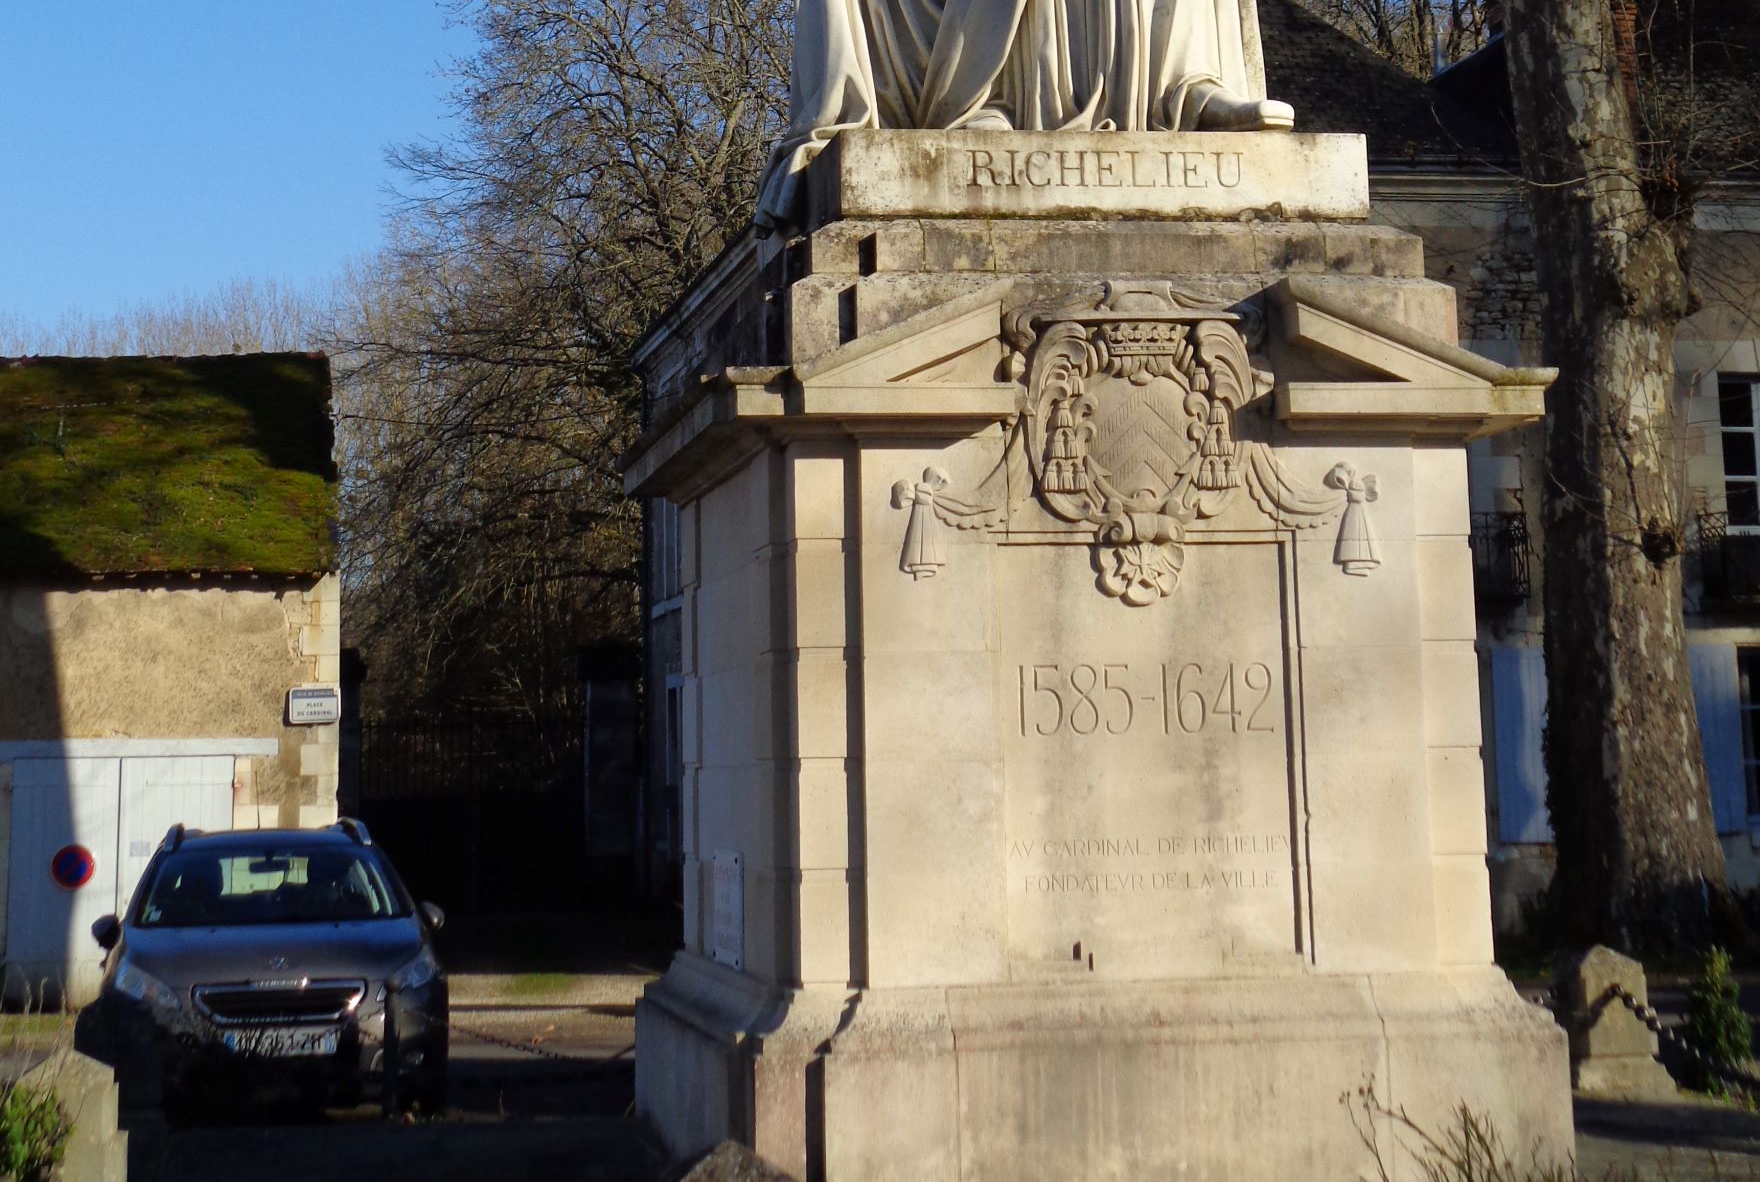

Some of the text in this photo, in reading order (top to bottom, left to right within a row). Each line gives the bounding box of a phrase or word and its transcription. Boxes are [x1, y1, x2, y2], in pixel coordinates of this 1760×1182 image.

[965, 149, 1244, 189] RICHELIEU
[1018, 662, 1275, 737] 1585-1642
[1043, 838, 1149, 857] CARDINAL
[1158, 836, 1185, 854] DE
[1152, 871, 1177, 889] DE
[1186, 871, 1212, 889] LA
[1221, 869, 1280, 889] VILLE
